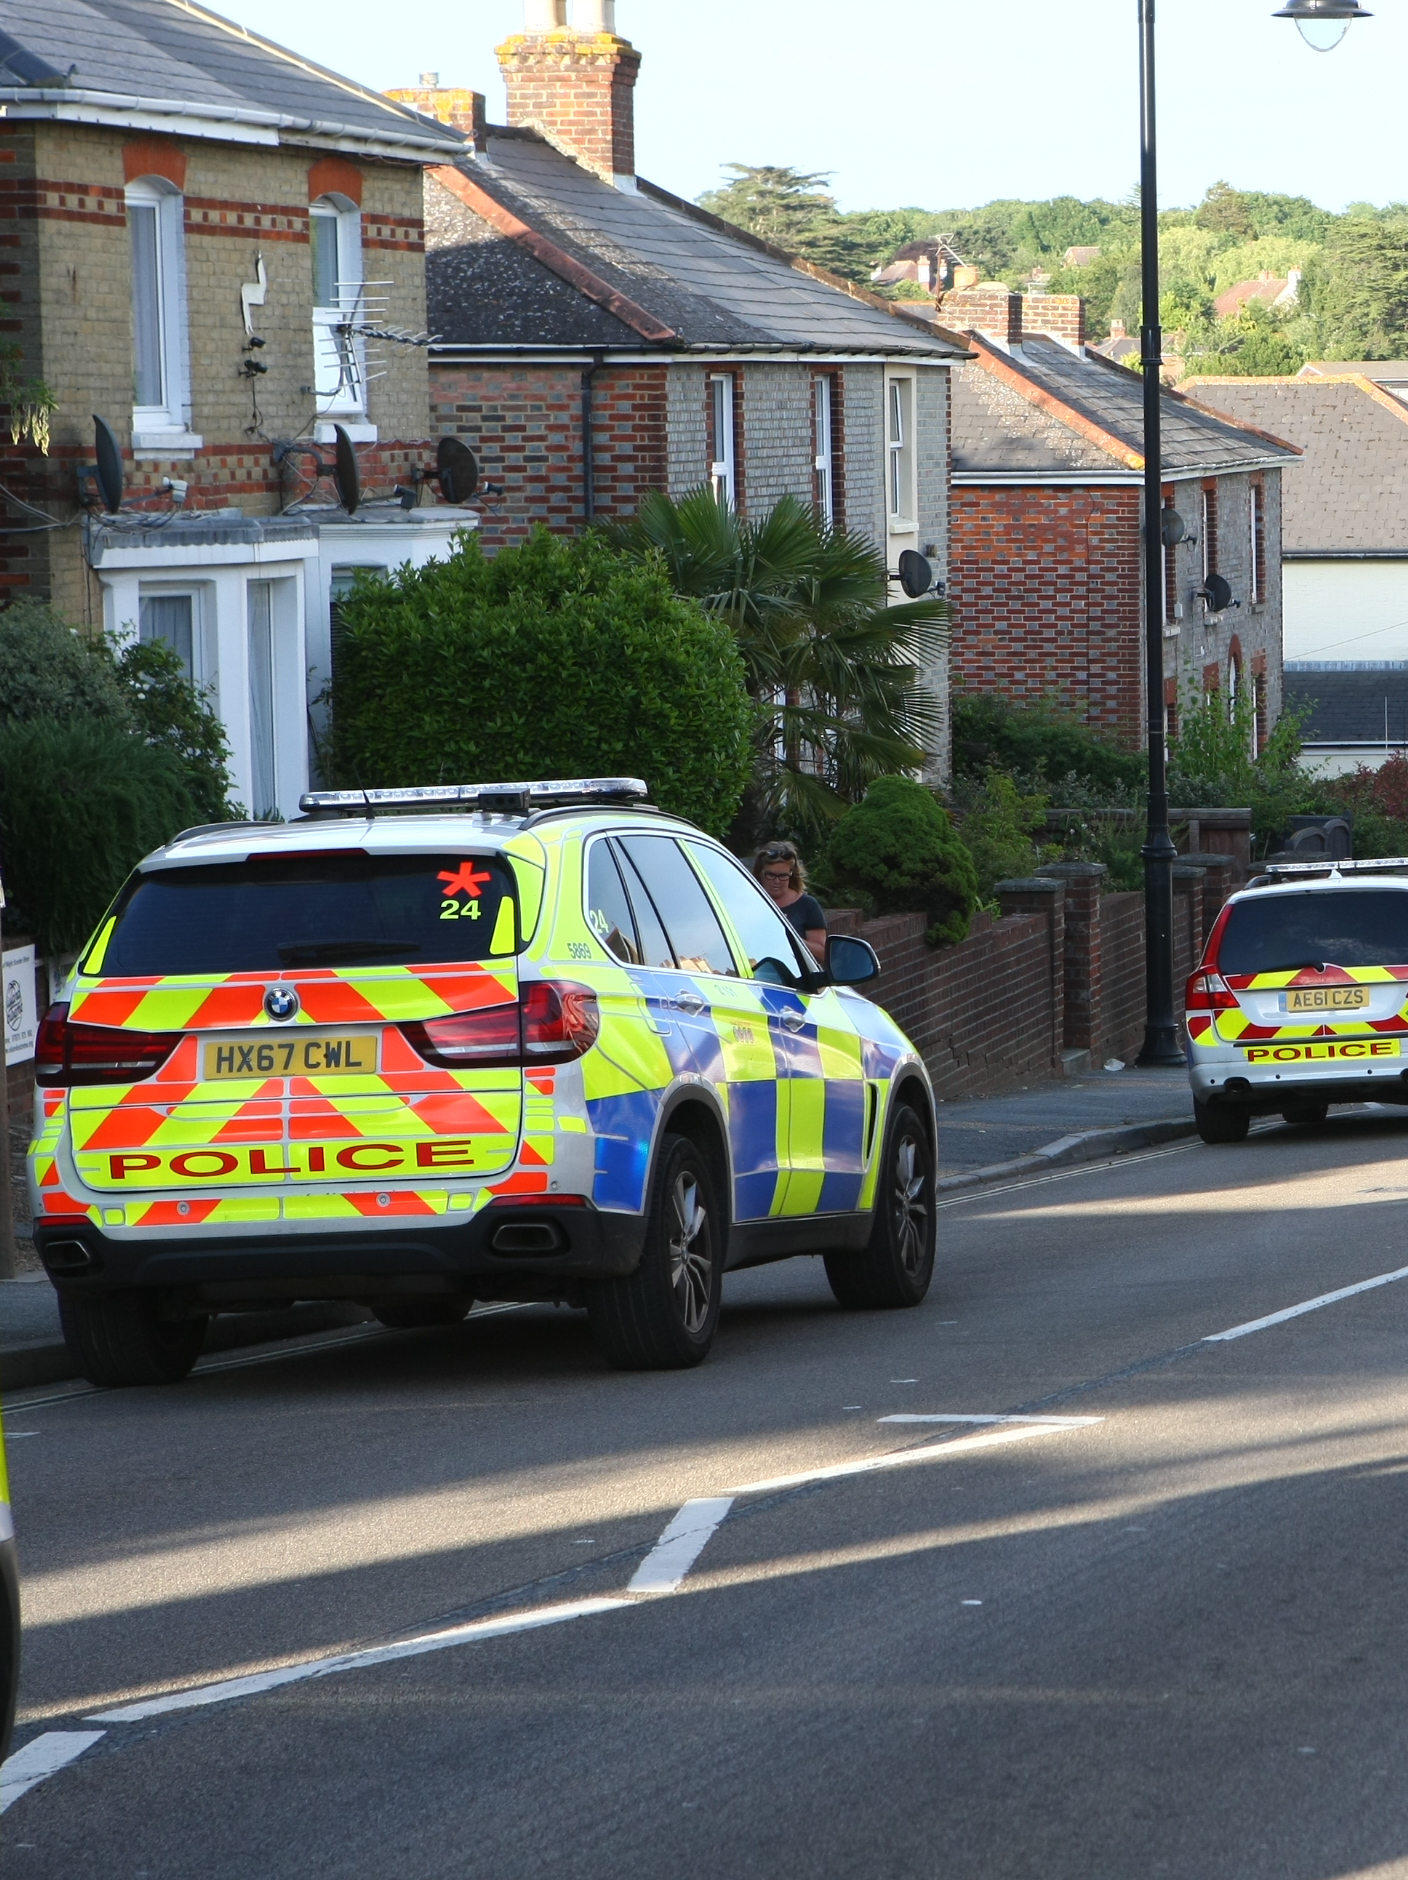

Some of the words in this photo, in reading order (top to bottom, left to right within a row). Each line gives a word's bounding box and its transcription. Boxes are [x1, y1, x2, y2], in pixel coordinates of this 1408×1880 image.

[439, 899, 482, 920] 24
[589, 909, 610, 935] 24
[566, 942, 592, 960] 5869
[1292, 990, 1329, 1008] AE61
[1332, 989, 1364, 1005] CZS
[215, 1042, 296, 1074] HX67
[304, 1039, 362, 1070] CWL
[1247, 1041, 1394, 1063] POLICE
[109, 1140, 475, 1180] POLICE
